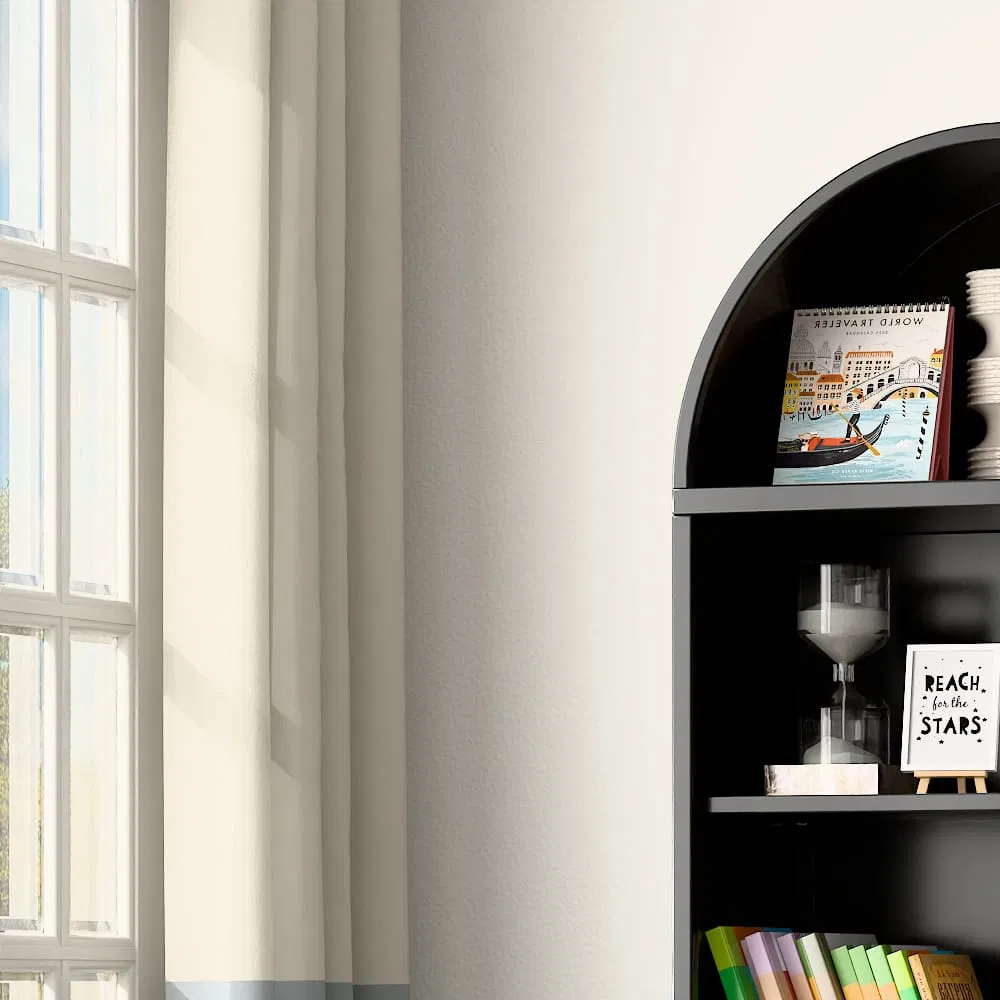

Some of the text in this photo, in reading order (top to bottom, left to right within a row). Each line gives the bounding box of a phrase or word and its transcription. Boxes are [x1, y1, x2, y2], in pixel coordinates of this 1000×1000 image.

[925, 671, 980, 693] REACH
[932, 695, 969, 711] for the
[920, 715, 982, 736] STARS
